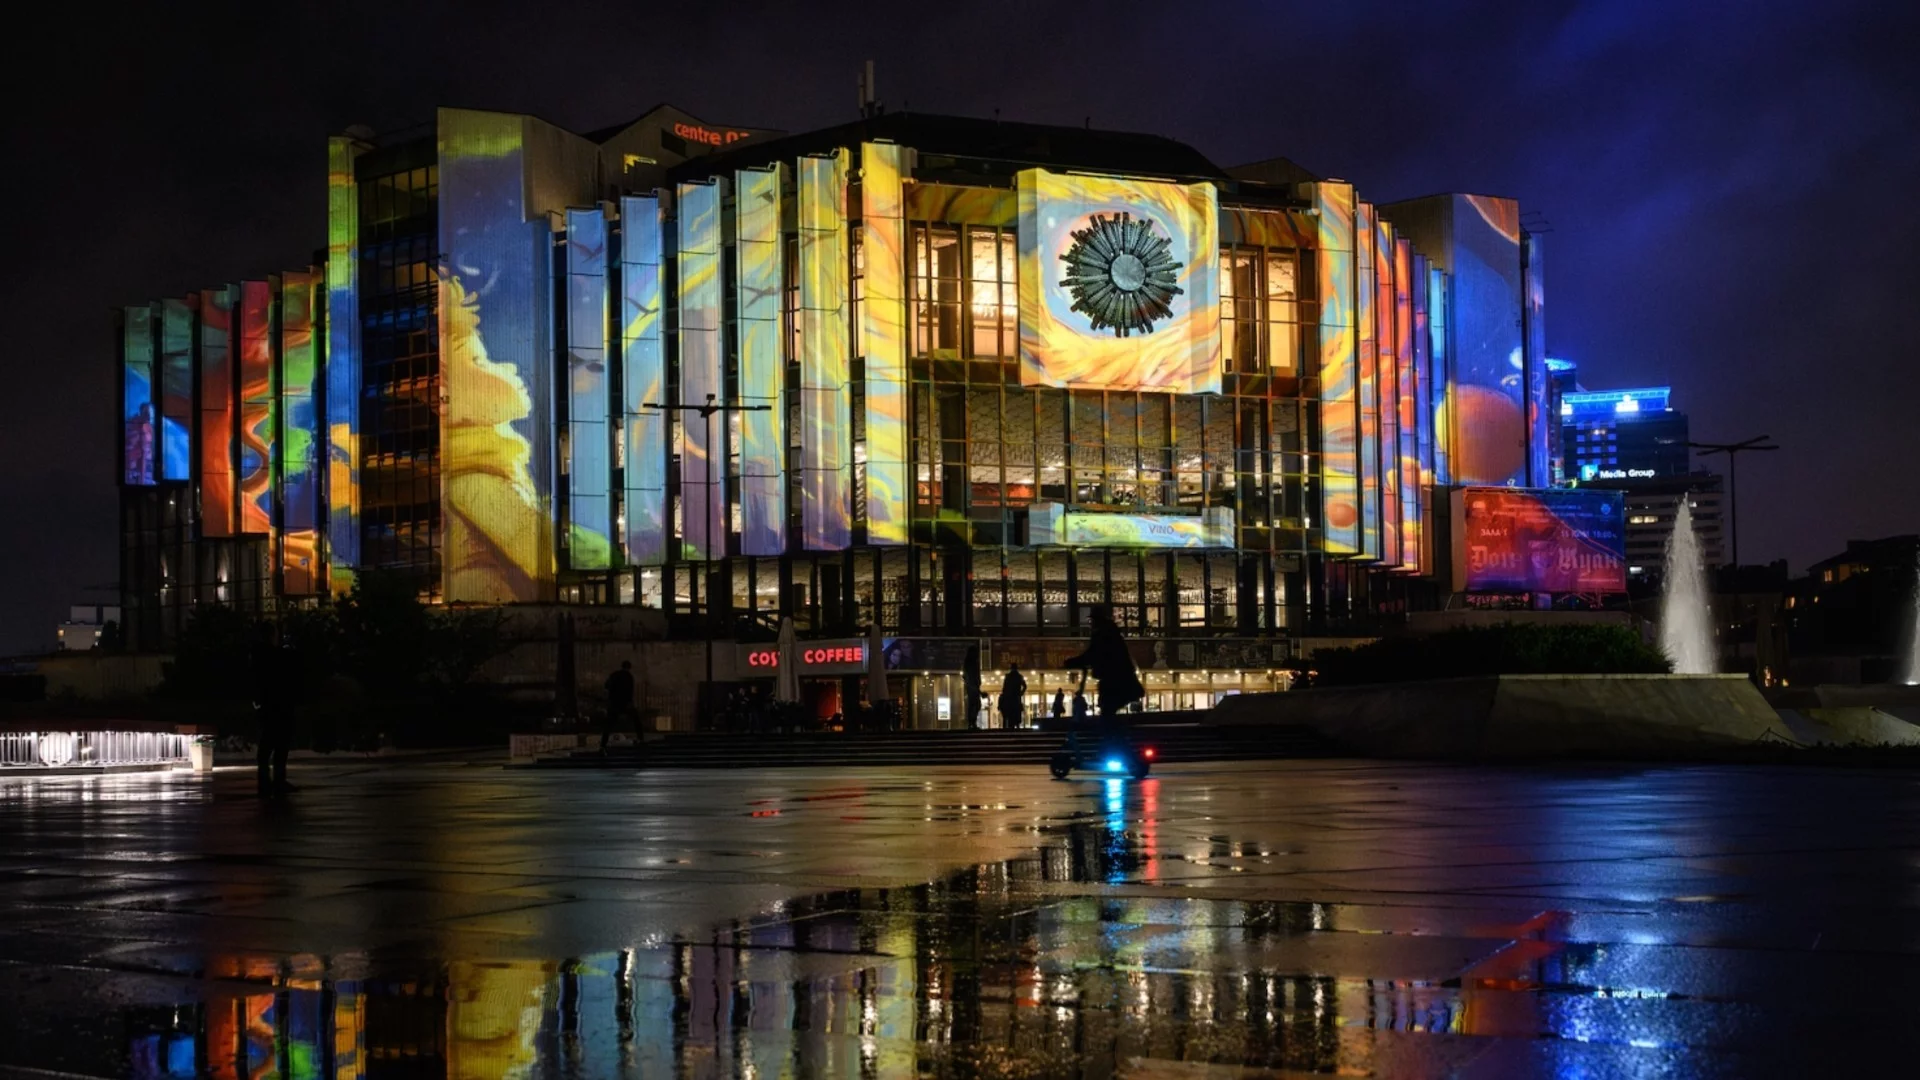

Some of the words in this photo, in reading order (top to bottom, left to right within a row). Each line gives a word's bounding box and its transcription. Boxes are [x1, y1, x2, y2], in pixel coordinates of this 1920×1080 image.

[674, 122, 722, 146] centre
[1600, 469, 1626, 479] Media
[1628, 468, 1656, 479] Group
[1148, 524, 1175, 535] VINO
[804, 646, 863, 664] COFFEE
